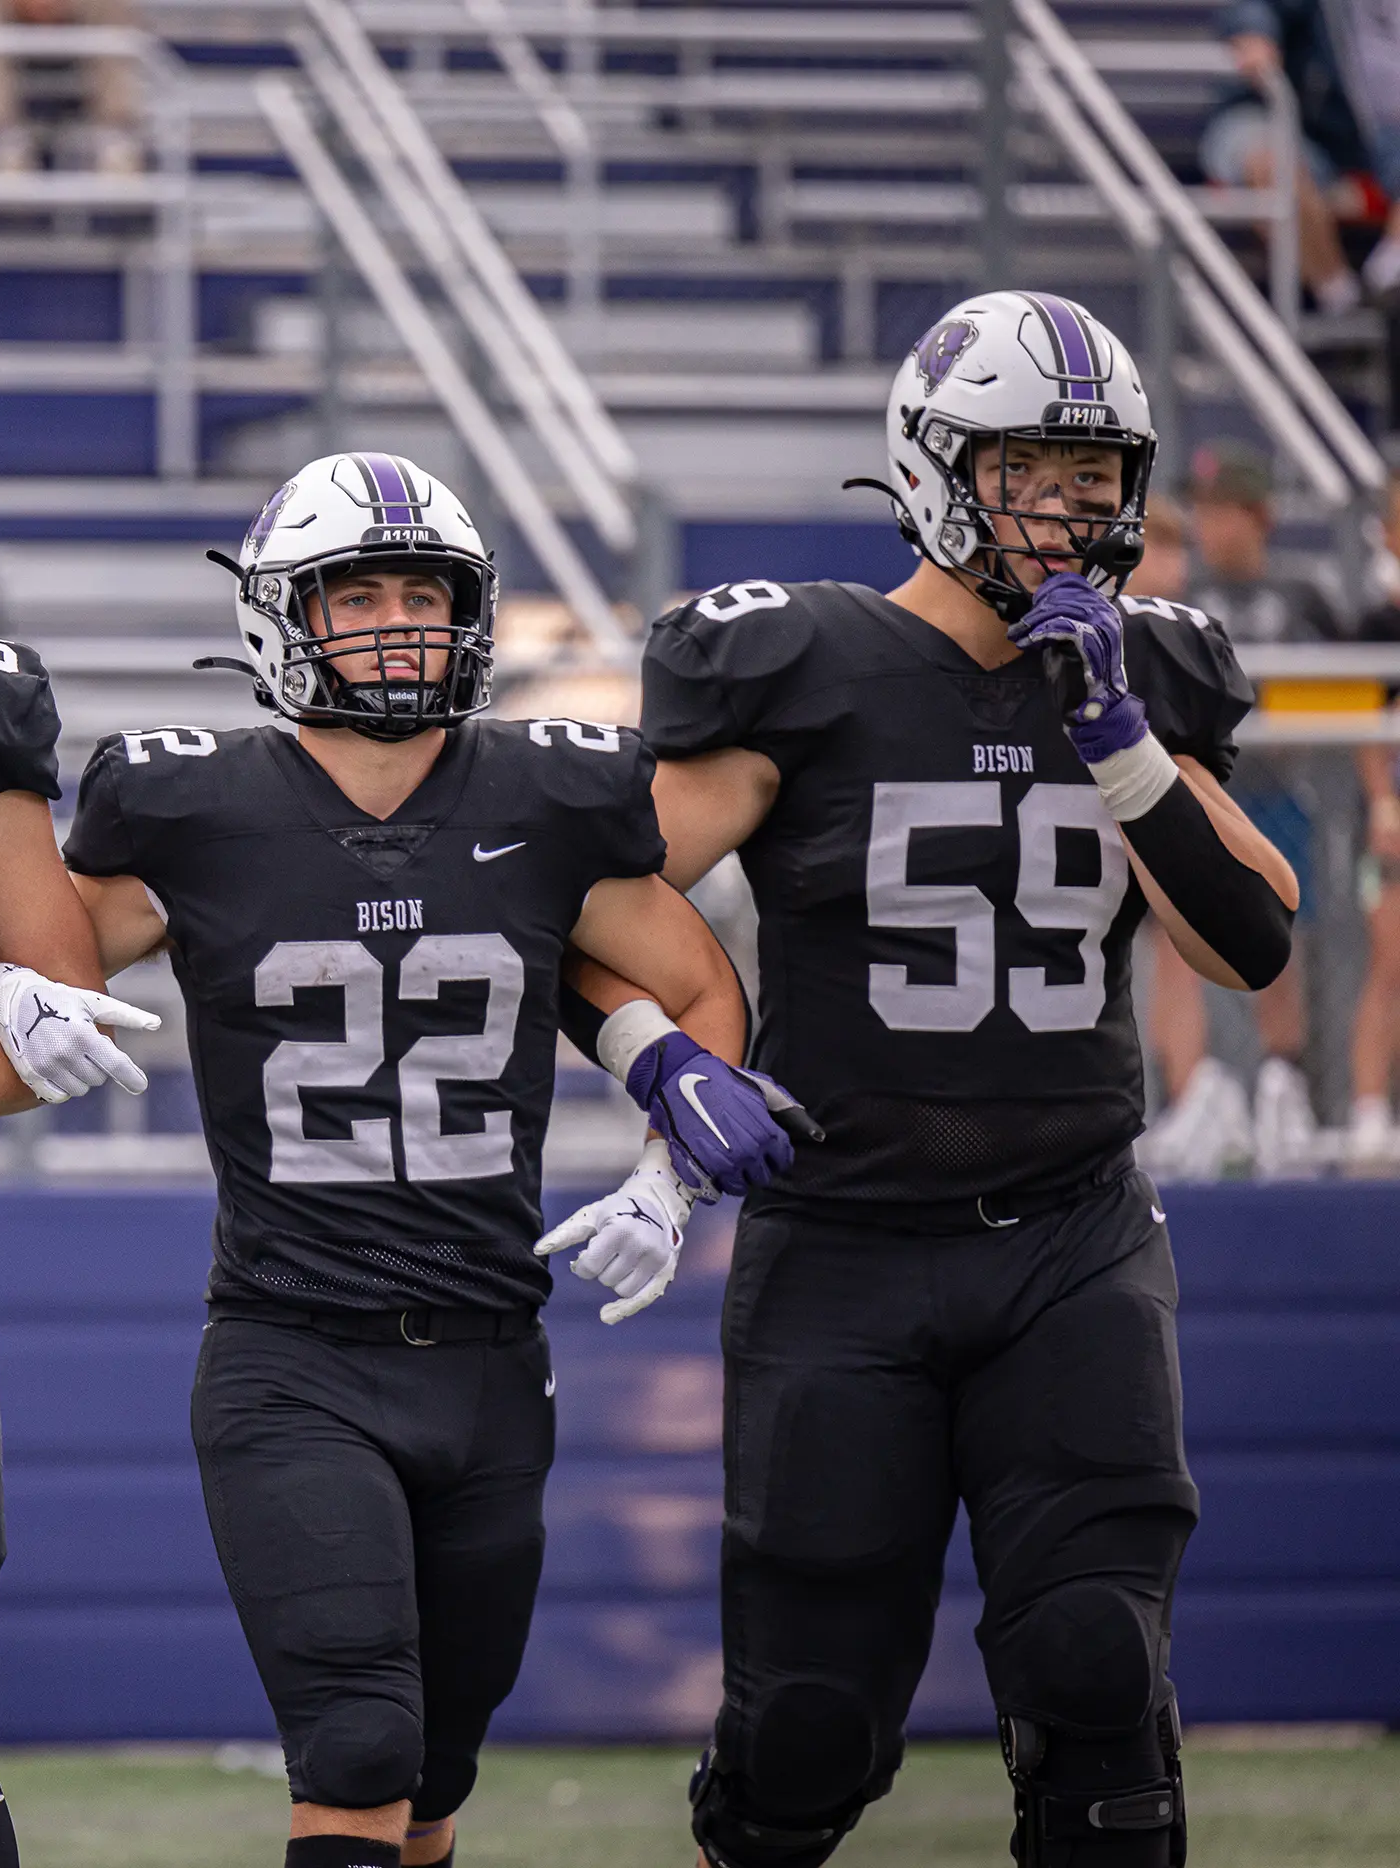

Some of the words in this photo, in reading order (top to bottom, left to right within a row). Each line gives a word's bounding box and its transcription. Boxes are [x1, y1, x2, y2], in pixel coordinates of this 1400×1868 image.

[680, 579, 791, 623] 9
[1118, 594, 1209, 630] 5
[120, 725, 218, 764] 2
[528, 716, 620, 753] 2
[972, 744, 1034, 773] BISON
[357, 899, 424, 932] BISON
[866, 781, 1129, 1033] 59
[254, 932, 525, 1184] 22
